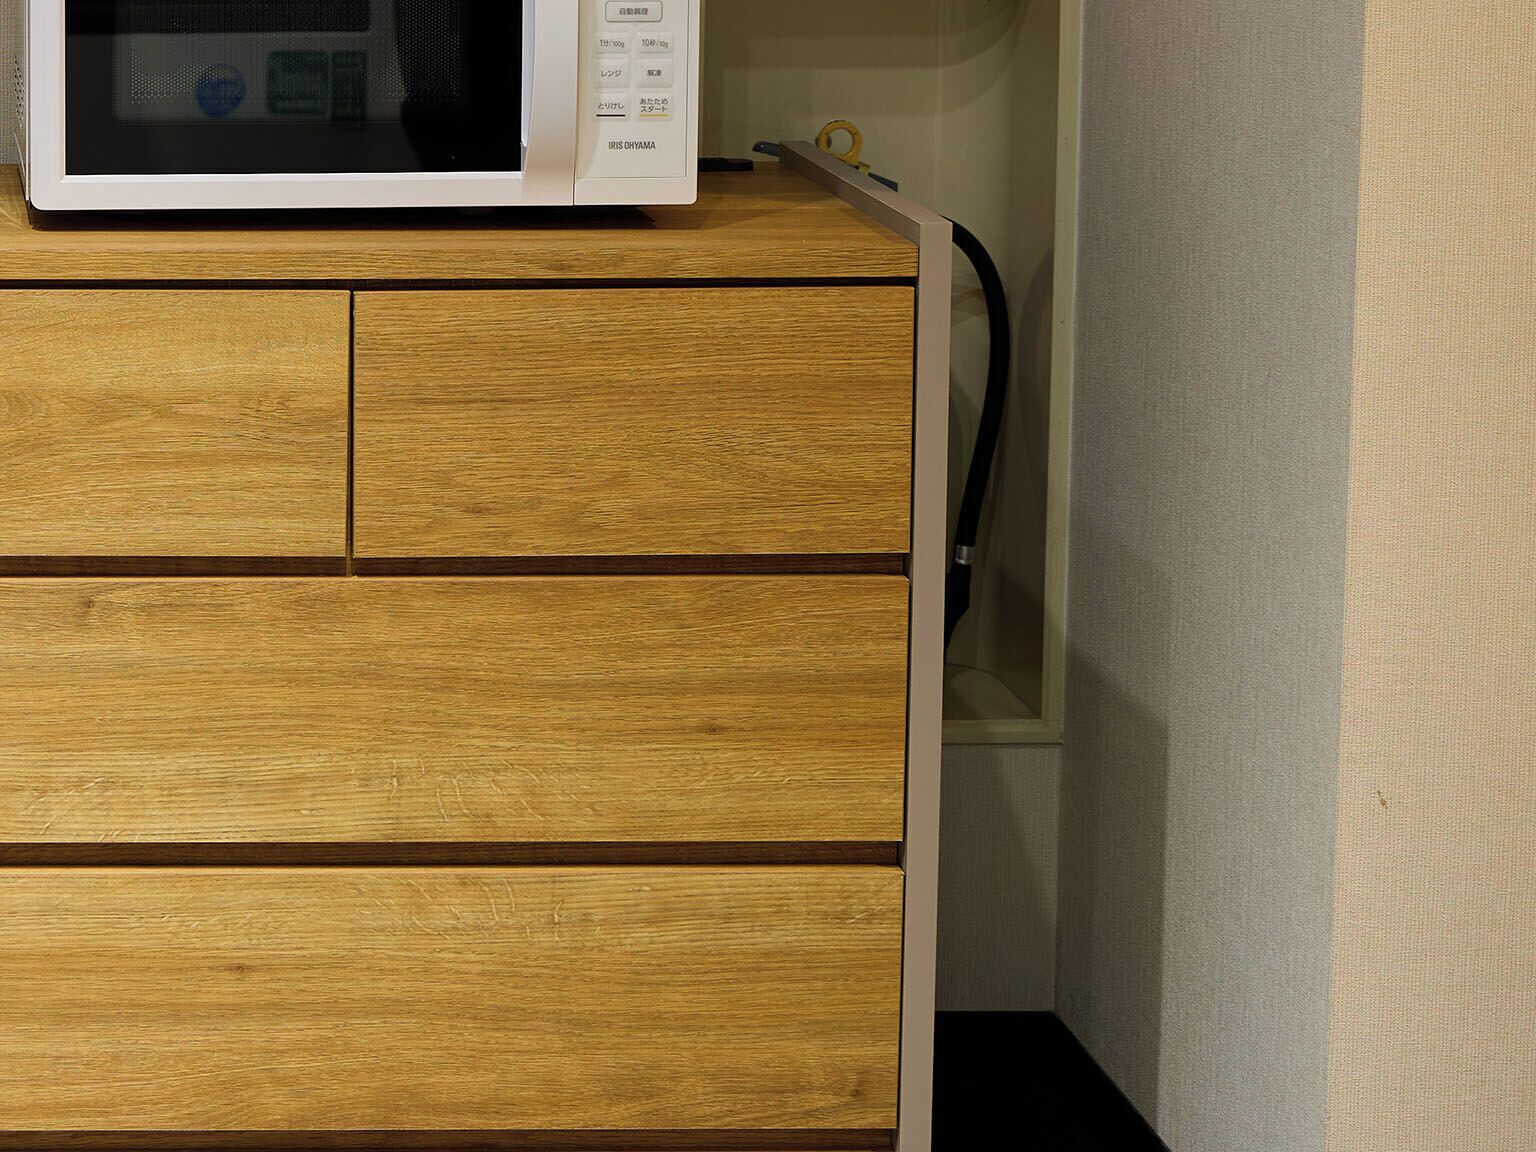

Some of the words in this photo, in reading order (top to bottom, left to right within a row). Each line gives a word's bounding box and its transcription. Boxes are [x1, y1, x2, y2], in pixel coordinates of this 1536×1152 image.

[600, 69, 622, 78] レンジ
[640, 98, 669, 106] あたため
[640, 105, 668, 113] スタート
[608, 141, 623, 150] IRIS
[624, 141, 656, 150] OHYAMA
